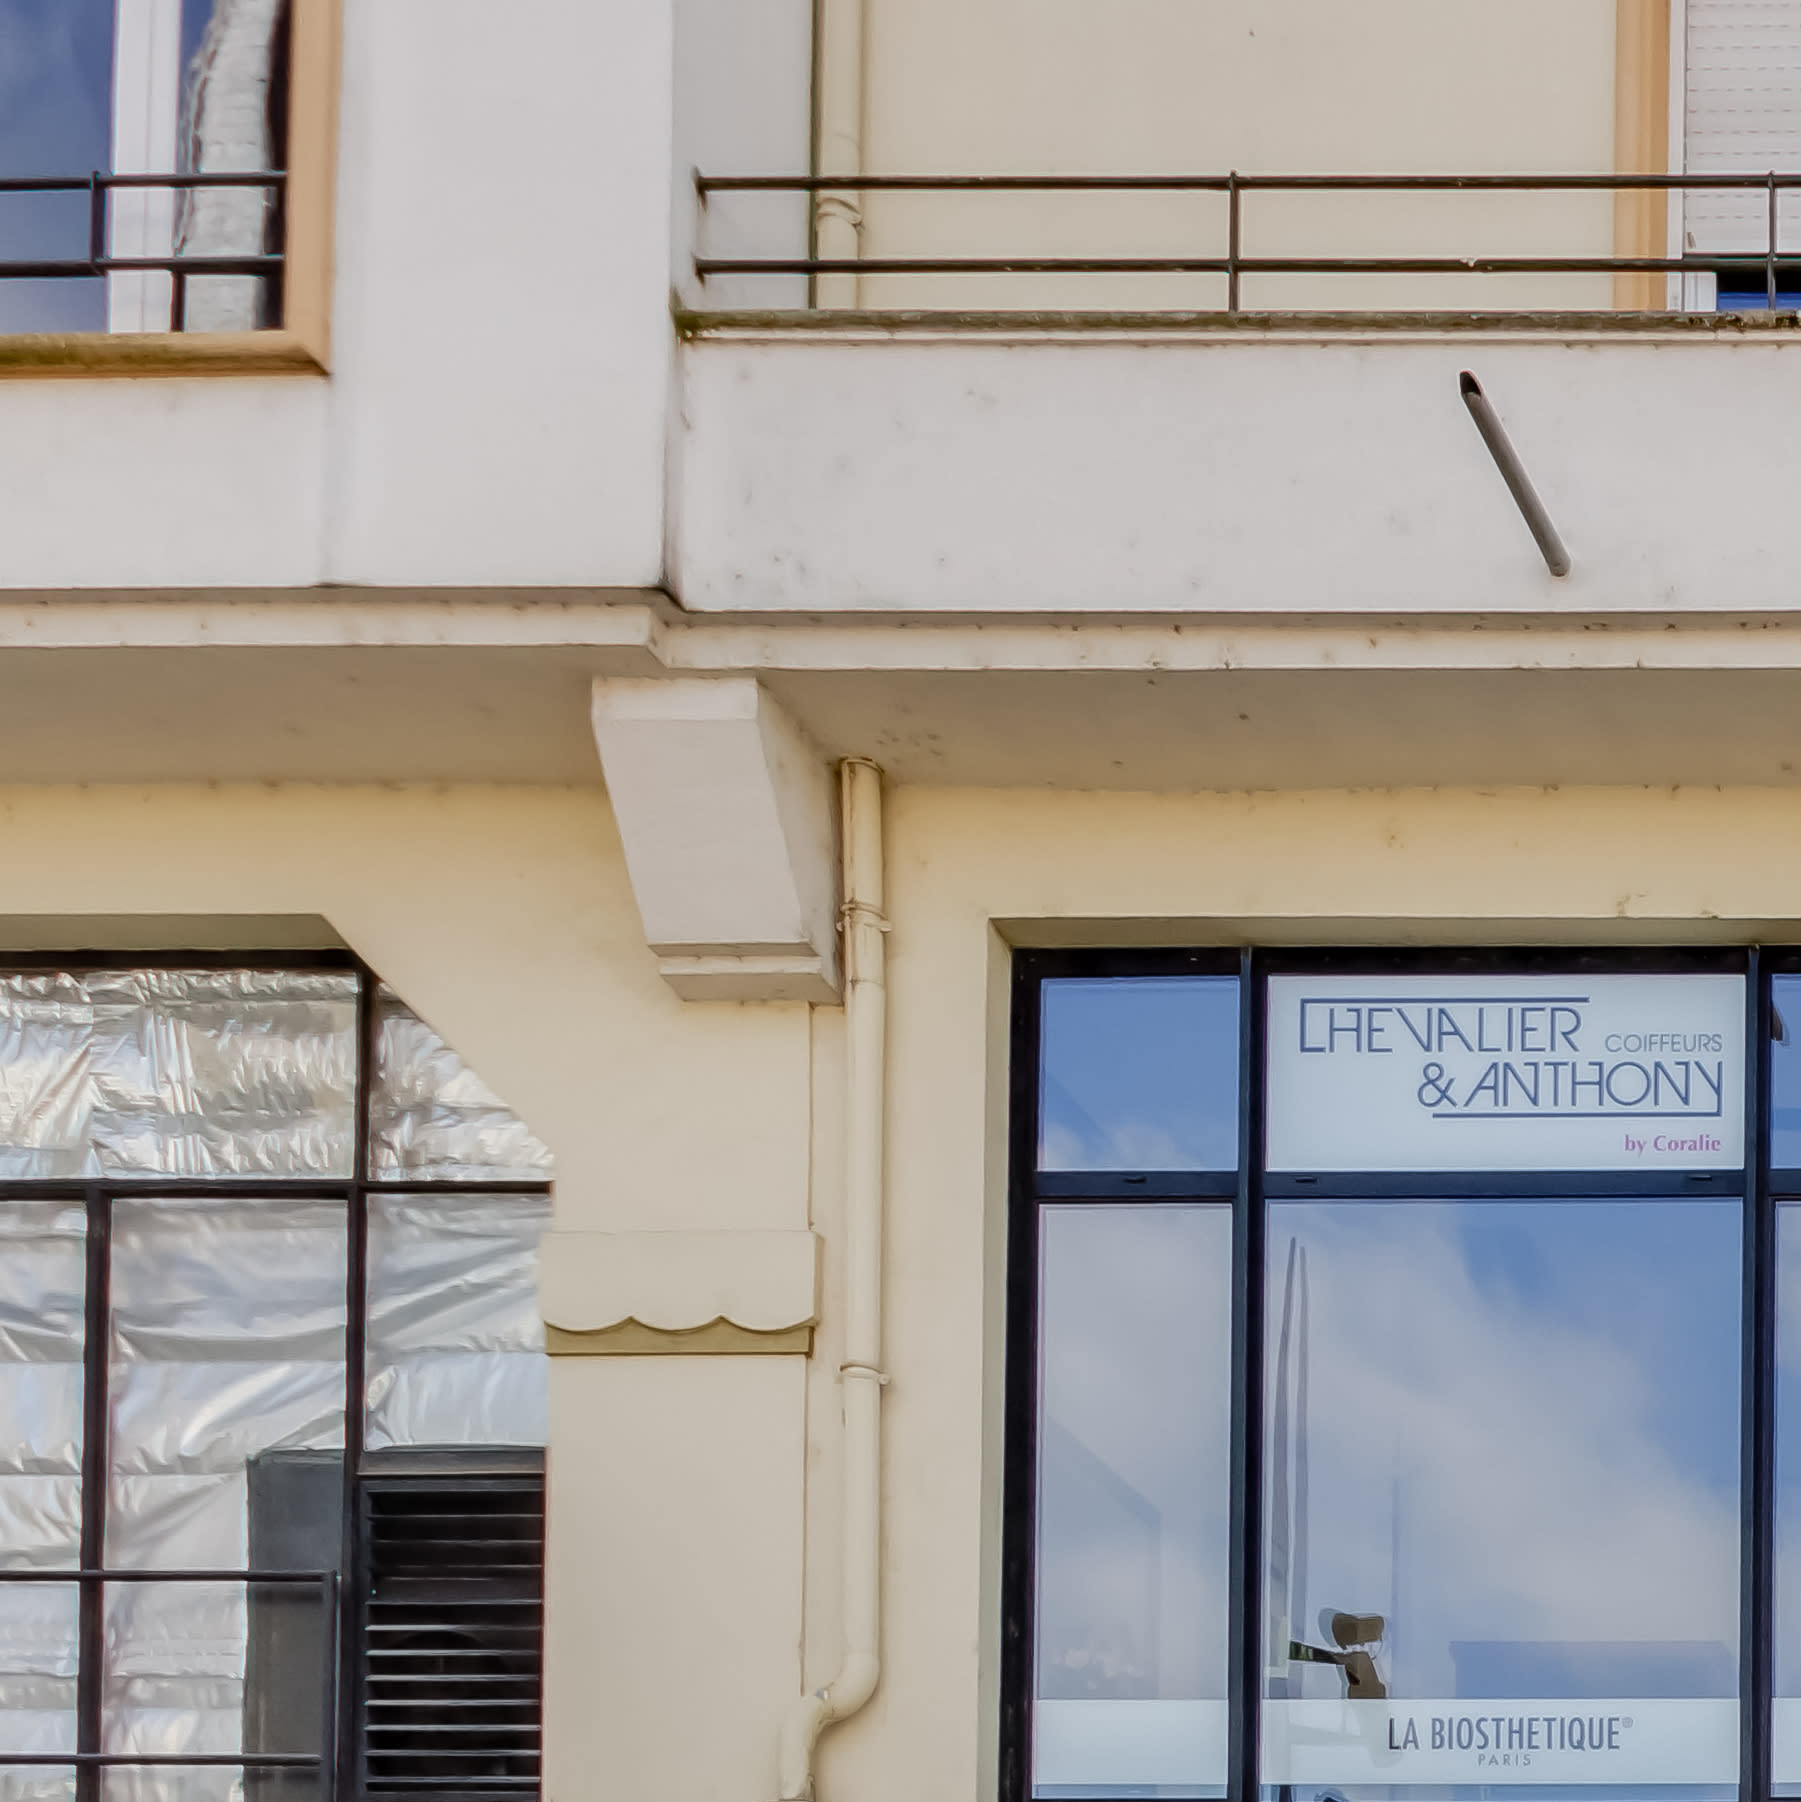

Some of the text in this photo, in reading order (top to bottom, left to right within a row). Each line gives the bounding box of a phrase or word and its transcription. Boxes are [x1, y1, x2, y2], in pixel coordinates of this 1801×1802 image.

[1299, 996, 1723, 1053] CHEVALIER COIFFEURS
[1463, 1060, 1723, 1117] ANTHONY
[1624, 1134, 1722, 1155] by Coralie
[1388, 1716, 1420, 1751] LA
[1477, 1753, 1532, 1767] PARIS
